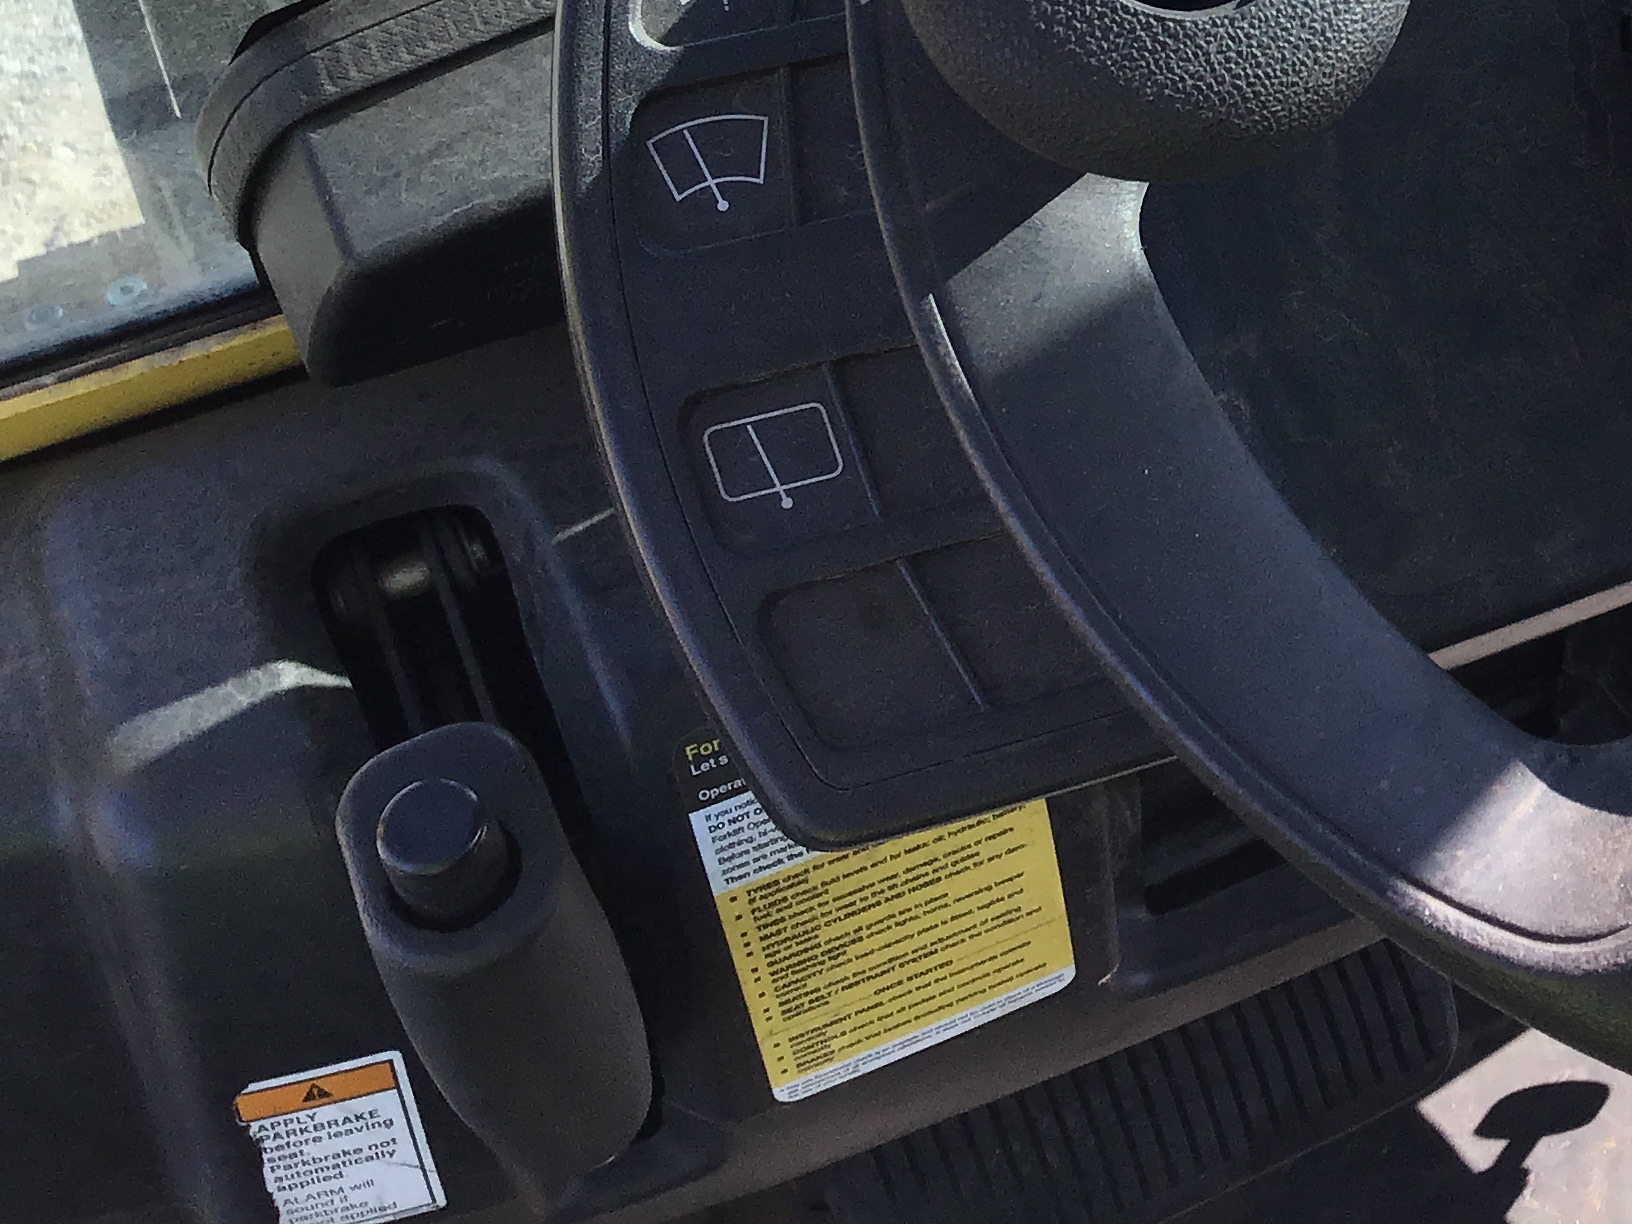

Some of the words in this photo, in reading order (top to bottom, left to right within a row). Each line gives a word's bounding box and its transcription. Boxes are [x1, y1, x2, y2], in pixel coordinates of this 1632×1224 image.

[685, 739, 720, 761] For
[708, 821, 726, 833] DO
[727, 811, 752, 826] NOT
[713, 807, 733, 820] you
[711, 826, 745, 843] Forklift
[717, 848, 751, 865] Before
[720, 860, 751, 876] zones
[752, 853, 768, 863] are
[724, 871, 751, 885] Then
[753, 858, 785, 874] check
[787, 850, 804, 861] the
[746, 879, 780, 896] TYRES
[782, 868, 810, 882] check
[828, 854, 850, 865] wear
[751, 895, 788, 914] FLUIDS
[790, 883, 819, 899] check
[821, 875, 840, 887] fluid
[842, 864, 868, 878] levels
[756, 916, 786, 931] TINES
[788, 904, 816, 919] check
[832, 882, 876, 902] excessive
[943, 843, 972, 858] cracks
[985, 827, 1014, 842] repairs
[759, 926, 788, 941] MAST
[790, 914, 818, 929] check
[835, 900, 857, 912] wear
[951, 852, 981, 867] guides
[762, 924, 821, 951] HYDRAULIC
[824, 900, 882, 926] CYLINDERS
[884, 890, 906, 903] AND
[908, 876, 942, 893] HOSES
[944, 864, 971, 879] check
[796, 889, 829, 905] coolant
[767, 942, 822, 967] GUARDING
[823, 931, 851, 945] check
[865, 913, 897, 930] guards
[925, 893, 949, 906] place
[769, 953, 819, 977] WARNING
[821, 936, 864, 956] DEVICES
[866, 924, 892, 938] check
[953, 885, 993, 904] reversing
[995, 872, 1025, 887] beeper
[795, 934, 819, 946] leaks
[774, 968, 824, 992] CAPACITY
[825, 957, 853, 971] check
[917, 922, 939, 935] plate
[778, 986, 821, 1006] SEATING
[823, 974, 850, 989] check
[868, 952, 909, 971] condition
[930, 923, 978, 946] adjustment
[781, 1002, 805, 1015] SEAT
[808, 991, 833, 1004] BELT
[841, 965, 897, 991] RESTRAINT
[899, 948, 938, 967] SYSTEM
[940, 937, 966, 951] check
[984, 914, 1024, 933] condition
[791, 959, 826, 975] flashing
[828, 950, 847, 961] light
[874, 980, 904, 995] ONCE
[907, 960, 953, 982] STARTED
[789, 1013, 853, 1042] INSTRUMENT
[854, 1000, 883, 1015] PANEL
[887, 988, 913, 1002] check
[792, 1030, 847, 1055] CONTROLS
[848, 1018, 875, 1032] check
[993, 957, 1025, 974] operate
[796, 1049, 835, 1068] BRAKES
[838, 1038, 862, 1051] check
[1016, 962, 1047, 979] operate
[256, 1112, 318, 1134] APPLY
[258, 1109, 381, 1143] PARKBRAKE
[263, 1135, 323, 1155] before
[327, 1117, 394, 1139] leaving
[269, 1148, 363, 1173] Parkbrake
[368, 1138, 398, 1152] not
[273, 1149, 397, 1184] automatically
[283, 1186, 345, 1207] ALARM
[349, 1179, 375, 1191] will
[286, 1200, 335, 1216] sound
[339, 1195, 349, 1205] if
[339, 1201, 398, 1222] applied
